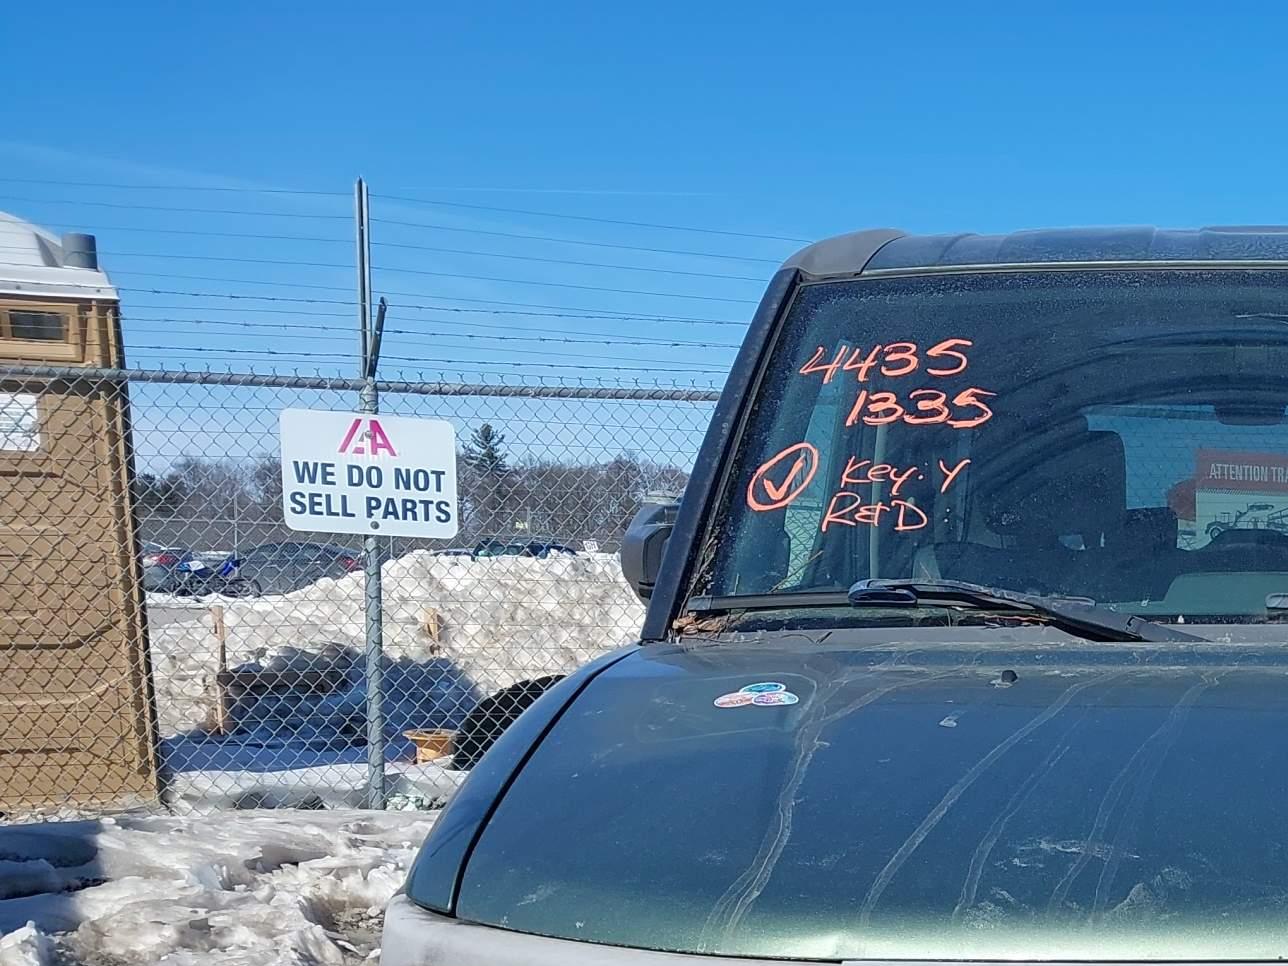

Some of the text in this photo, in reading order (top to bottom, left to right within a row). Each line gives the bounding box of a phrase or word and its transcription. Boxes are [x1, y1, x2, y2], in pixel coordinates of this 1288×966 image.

[799, 338, 973, 384] 4435
[845, 387, 998, 428] 1335
[293, 460, 446, 493] WE DO NOT
[1209, 462, 1269, 483] ATTENTION
[289, 491, 451, 524] SELL PARTS
